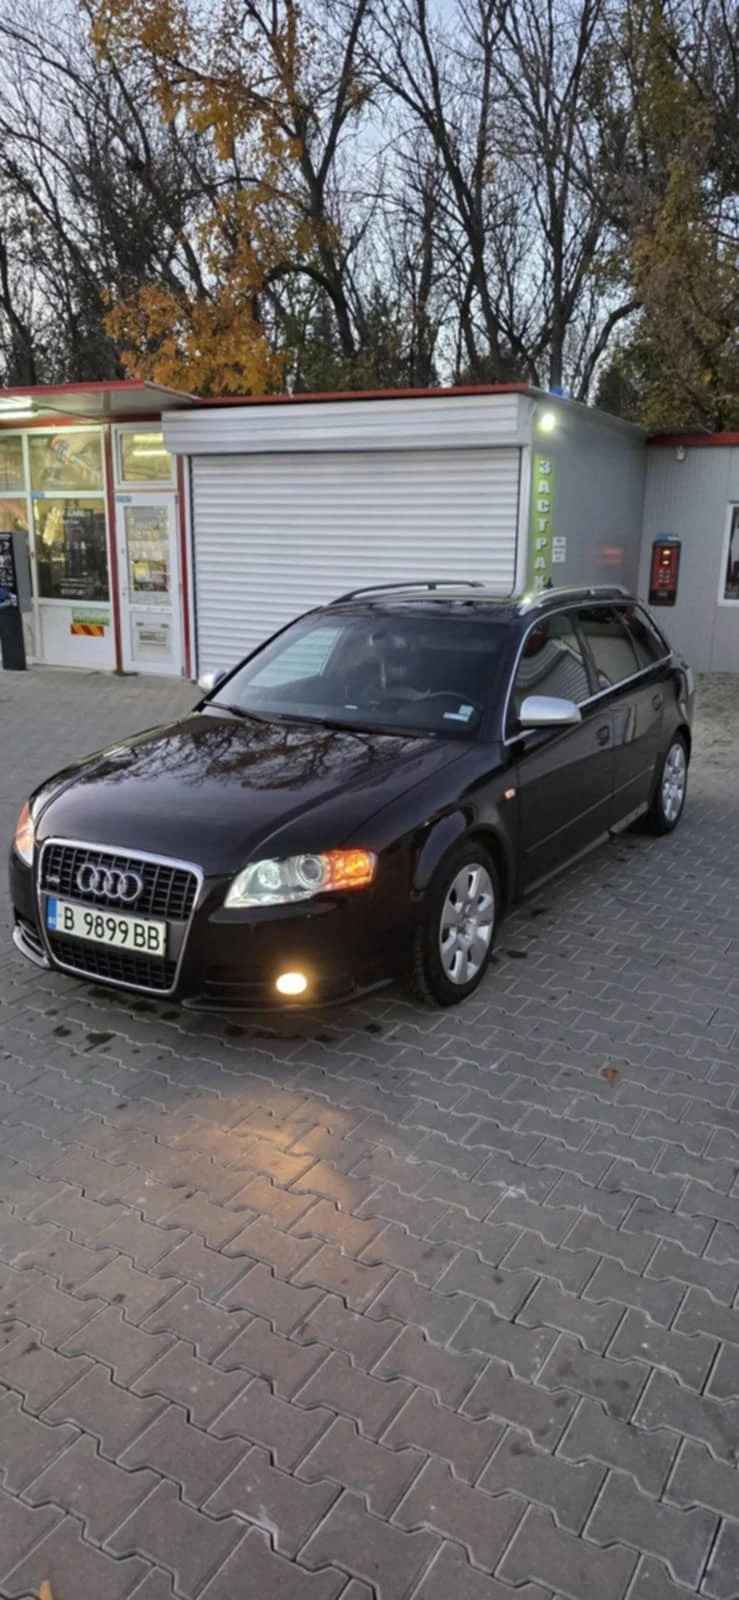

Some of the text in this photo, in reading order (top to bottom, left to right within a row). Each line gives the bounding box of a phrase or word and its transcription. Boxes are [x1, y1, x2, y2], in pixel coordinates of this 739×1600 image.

[64, 906, 160, 950] B 9899 BB
